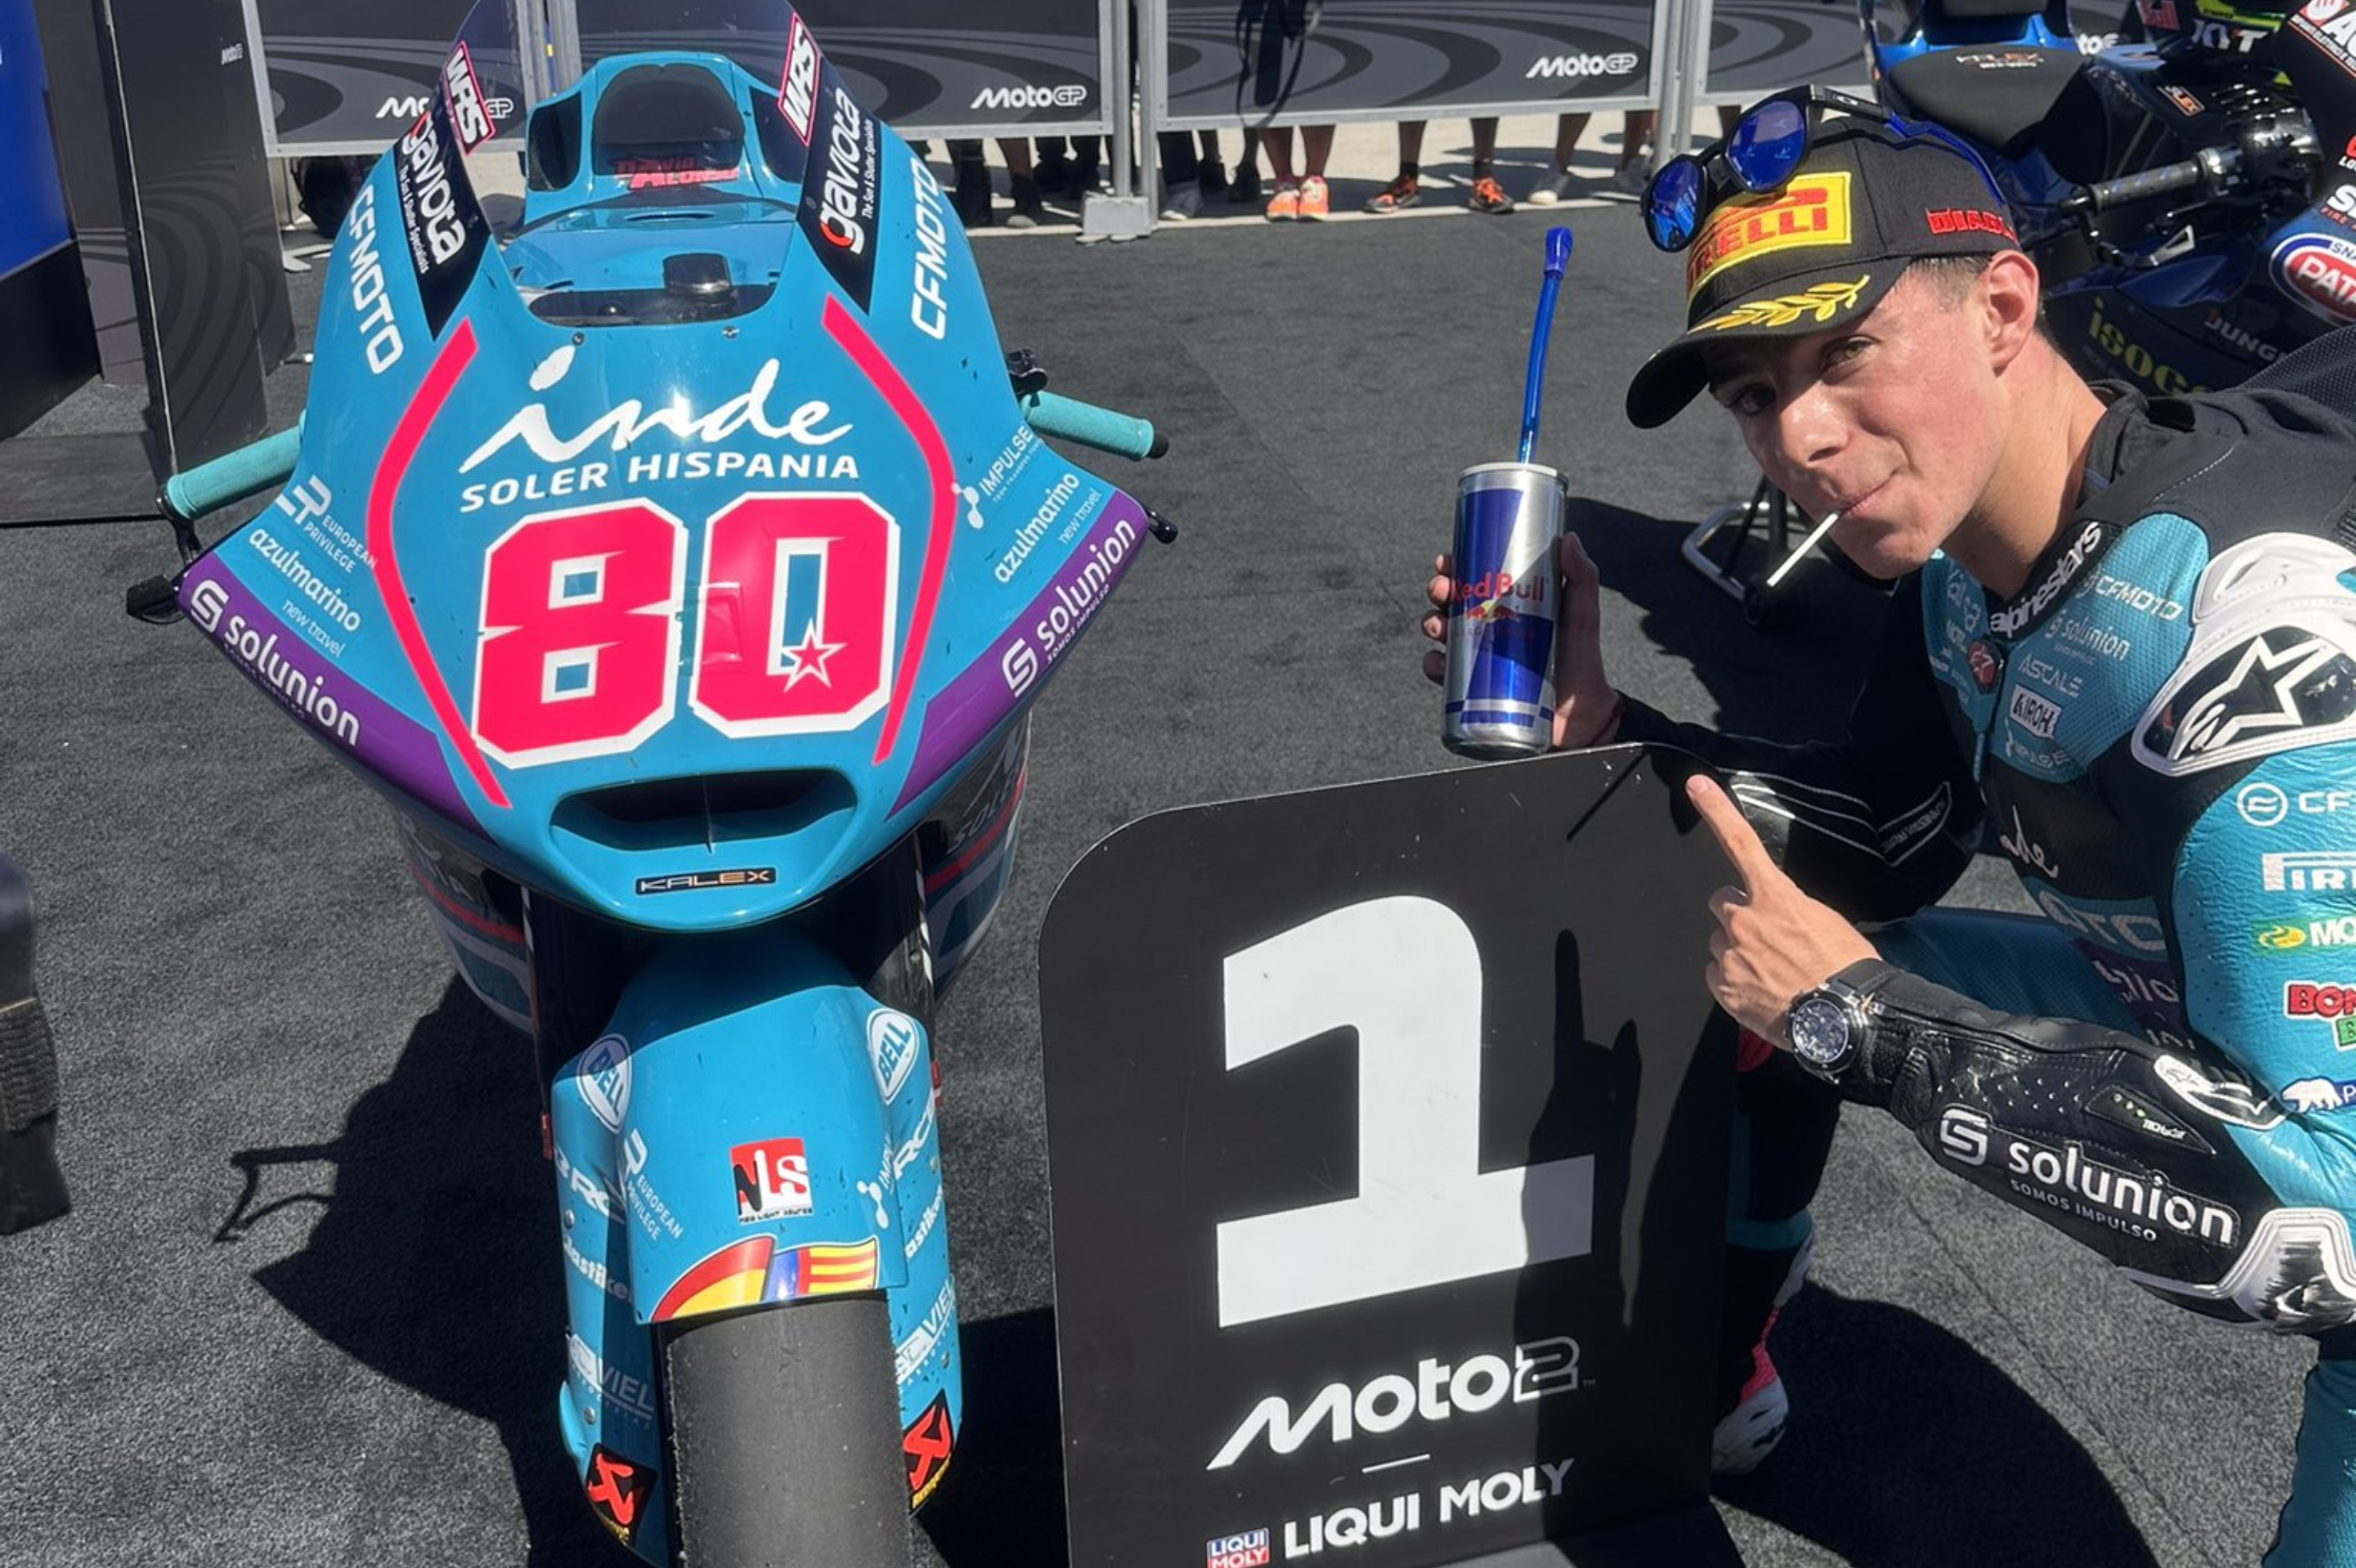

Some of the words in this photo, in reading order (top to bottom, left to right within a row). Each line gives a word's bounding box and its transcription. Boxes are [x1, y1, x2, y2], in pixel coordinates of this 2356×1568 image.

[970, 84, 1088, 110] MotoGP
[1526, 53, 1639, 79] MotoGP
[348, 184, 404, 375] CFMOTO
[911, 157, 949, 340] CFMOTO
[460, 345, 853, 473] inde
[460, 462, 609, 513] SOLER
[628, 452, 860, 483] HISPANIA
[978, 425, 1033, 496] IMPULSE
[304, 522, 358, 575] PRIVILEGE
[322, 513, 378, 570] EUROPEAN
[994, 472, 1081, 584] azulmarino
[1058, 516, 1081, 546] new
[1075, 488, 1103, 520] travel
[249, 527, 362, 632] azulmarino
[1036, 519, 1136, 651] solunion
[1496, 573, 1544, 602] Bull
[281, 598, 309, 630] new
[306, 621, 346, 658] travel
[471, 492, 900, 770] 80
[224, 614, 362, 747] solunion
[638, 869, 770, 892] KALEX
[596, 1046, 625, 1120] BELL
[877, 1021, 911, 1092] BELL
[1216, 895, 1595, 1329] 1
[637, 1174, 685, 1239] EUROPEAN
[2007, 1139, 2238, 1247] solunion
[2009, 1179, 2075, 1215] SOMOS
[2074, 1201, 2159, 1244] IMPULSO
[1206, 1335, 1581, 1471] Moto2
[1209, 1528, 1267, 1558] LIQUI
[1283, 1492, 1421, 1560] LIQUI
[1439, 1457, 1575, 1524] MOLY
[1211, 1547, 1270, 1568] MOLY
